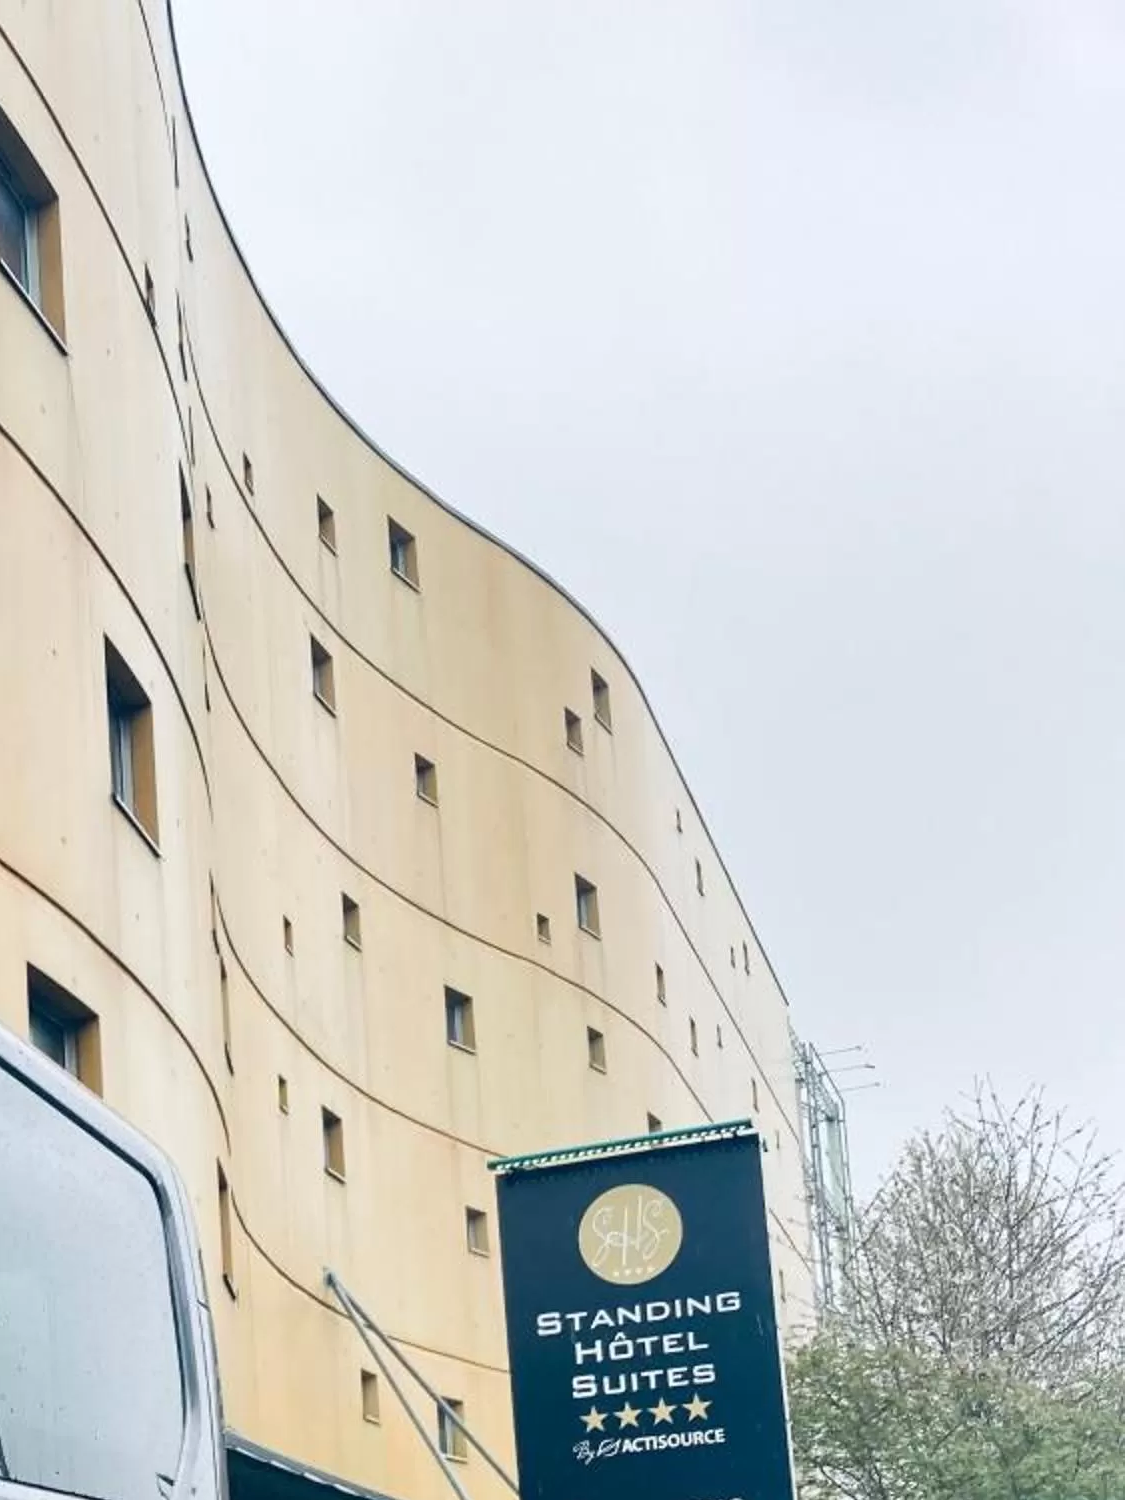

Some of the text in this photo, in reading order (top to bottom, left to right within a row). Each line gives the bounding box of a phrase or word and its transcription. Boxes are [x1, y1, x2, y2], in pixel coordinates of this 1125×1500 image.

[535, 1291, 742, 1337] STANDING
[574, 1331, 709, 1365] HÔTEL
[571, 1363, 716, 1399] SUITES
[621, 1428, 726, 1454] ACTISOURCE
